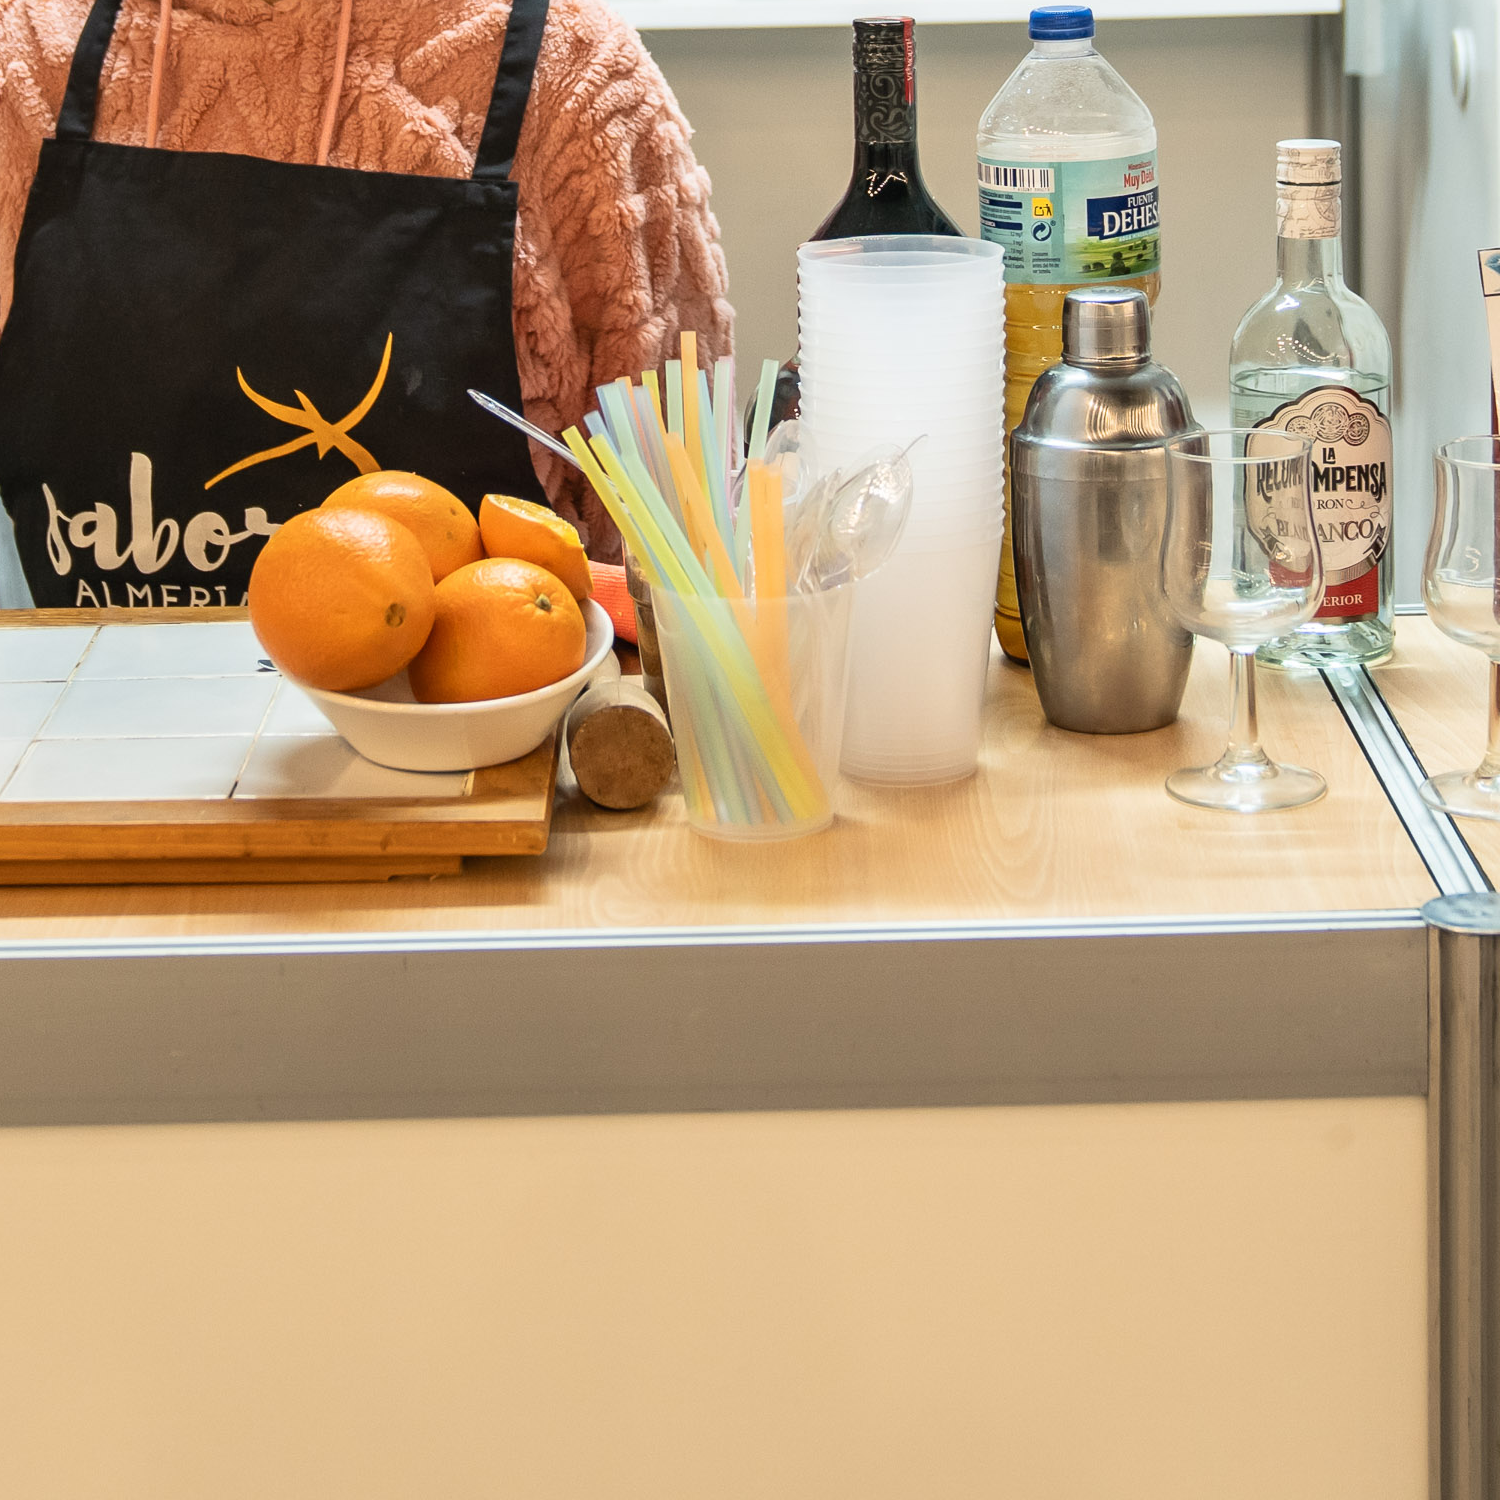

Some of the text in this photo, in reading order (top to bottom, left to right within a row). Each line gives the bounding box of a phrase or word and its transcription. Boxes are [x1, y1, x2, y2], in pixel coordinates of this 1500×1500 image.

[1123, 173, 1140, 190] Muy
[1127, 191, 1154, 208] FUENTE
[1102, 199, 1160, 237] DEHES
[1322, 447, 1336, 464] LA
[1317, 499, 1344, 510] RON
[75, 579, 250, 609] ALMERÍ
[1322, 593, 1364, 608] ERIOR
